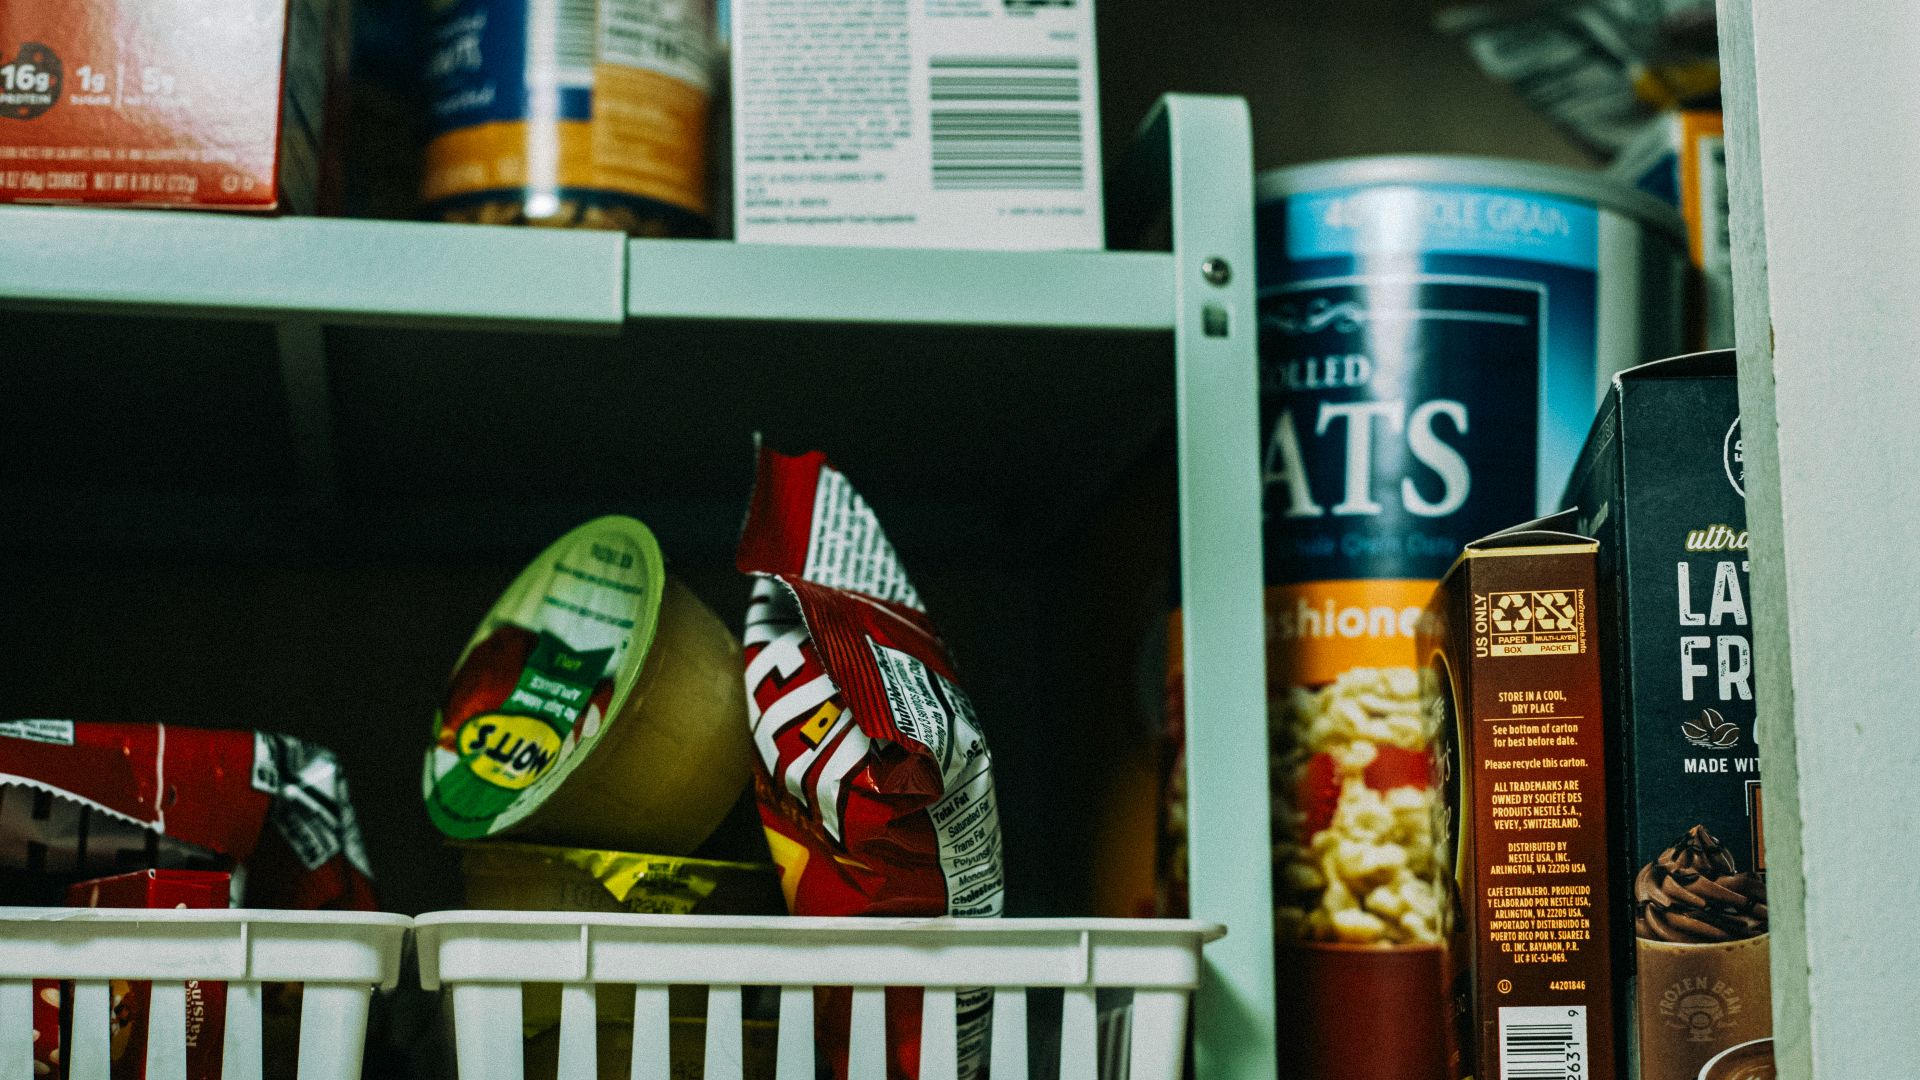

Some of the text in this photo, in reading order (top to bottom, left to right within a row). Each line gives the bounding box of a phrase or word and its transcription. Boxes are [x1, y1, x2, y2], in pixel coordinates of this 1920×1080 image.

[1, 64, 49, 92] 16g
[76, 65, 105, 93] 1g
[1678, 561, 1750, 626] LA
[1474, 594, 1489, 658] US ONLY
[1577, 589, 1588, 654] how2recycle.info
[1498, 636, 1527, 644] PAPER
[1535, 634, 1577, 642] MULTI-LAYER
[1504, 646, 1522, 654] BOX
[1680, 635, 1753, 701] FR
[1498, 690, 1567, 702] STORE IN A COOL,
[1512, 703, 1554, 714] DRY PLACE
[1492, 724, 1578, 735] See bottom of carton
[1494, 736, 1578, 748] for best before date.
[1484, 758, 1588, 770] Please recycle this carton.
[1684, 758, 1729, 773] MADE
[1494, 780, 1579, 792] ALL TRADEMARKS ARE
[1492, 791, 1582, 805] OWNED BY SOCIÉTÉ DES
[932, 792, 970, 824] Total Fat
[1492, 804, 1582, 818] PRODUITS NESTLÉ S.A.,
[948, 809, 981, 838] Saturated
[1494, 818, 1581, 831] VEVEY, SWITZERLAND.
[952, 828, 986, 854] Trans Fat
[1508, 842, 1567, 852] DISTRIBUTED BY
[1508, 852, 1571, 864] NESTLÉ USA, INC.
[1490, 863, 1586, 876] ARLINGTON, VA 22209 USA
[1488, 886, 1590, 897] CAFÉ EXTRANJERO. PRODUCIDO
[1488, 896, 1591, 908] Y ELABORADO POR NESTLÉ USA,
[1496, 908, 1584, 920] ARLINGTON, VA 22209 USA.
[1490, 919, 1590, 930] IMPORTADO Y DISTRIBUIDO EN
[1490, 930, 1590, 941] PUERTO RICO POR V. SUAREZ &
[1502, 943, 1512, 952] CO.
[1514, 943, 1528, 952] INC.
[1566, 942, 1579, 951] P.R.
[1514, 954, 1524, 964] LIC
[1550, 981, 1586, 990] 44201846
[1660, 976, 1708, 1016] FROZEN
[186, 981, 204, 1046] Raisins
